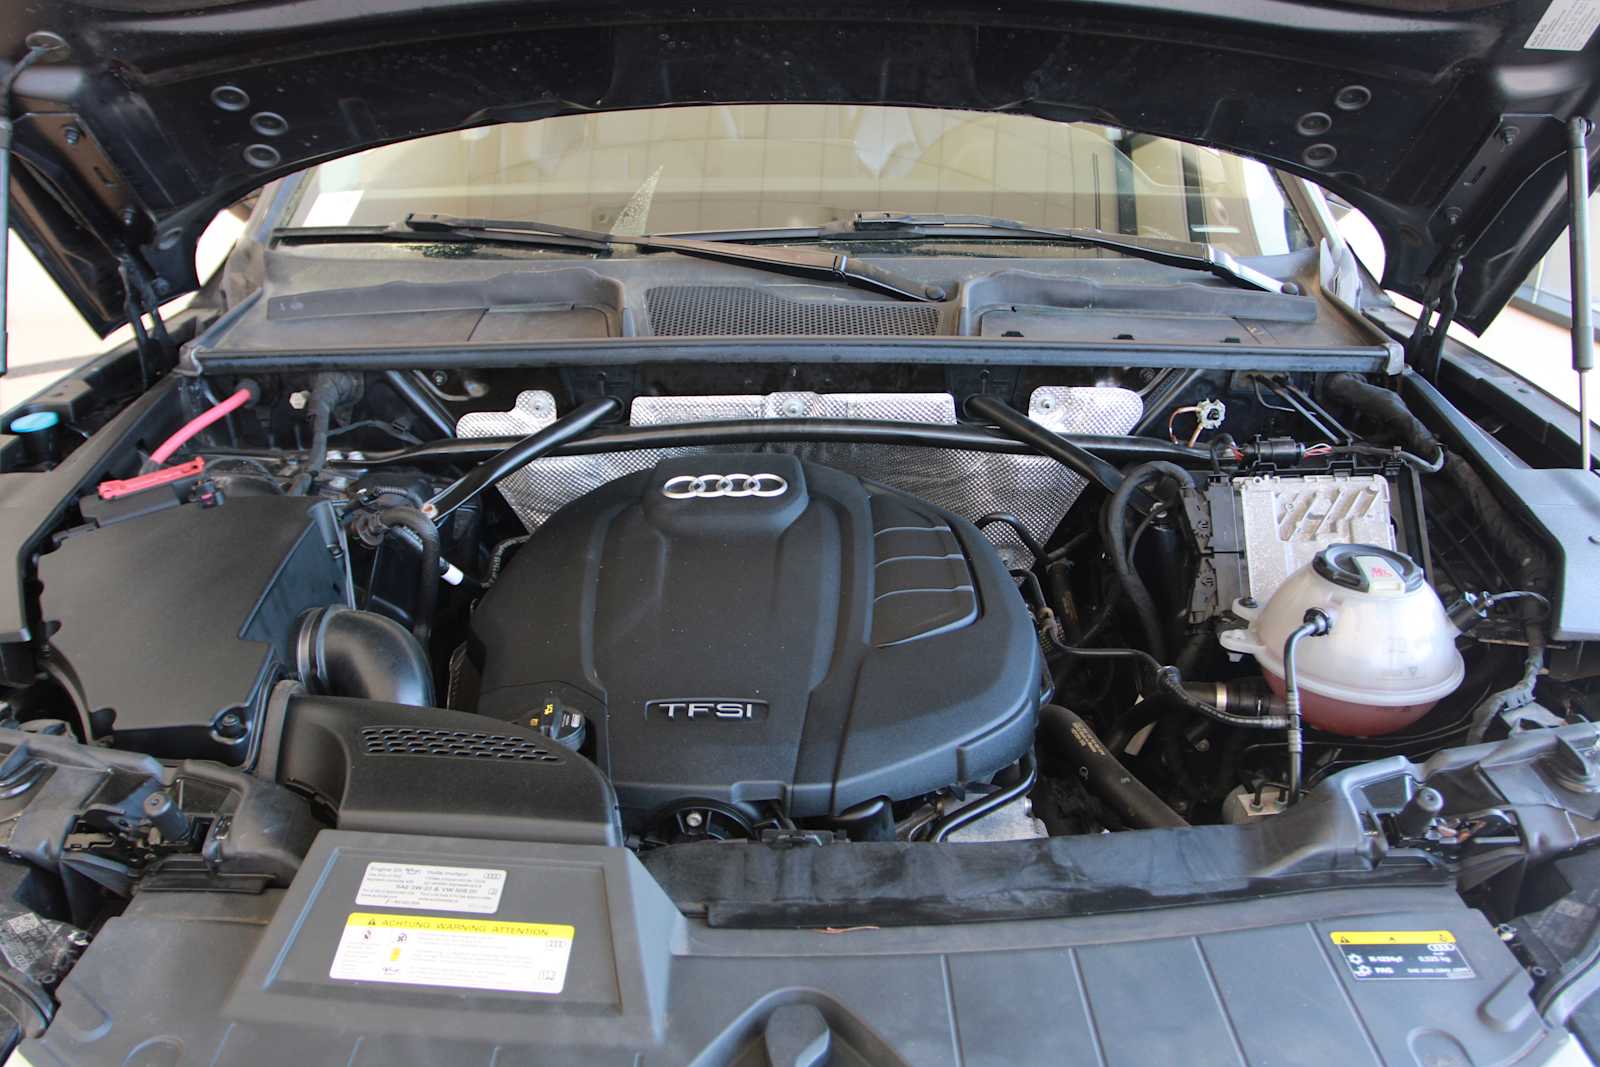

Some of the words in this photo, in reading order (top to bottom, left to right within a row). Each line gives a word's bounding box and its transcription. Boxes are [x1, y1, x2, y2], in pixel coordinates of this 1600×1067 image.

[659, 703, 752, 718] TFSI
[381, 919, 431, 929] ACHTUNG
[437, 923, 486, 933] WARNING
[492, 926, 549, 937] ATTENTION
